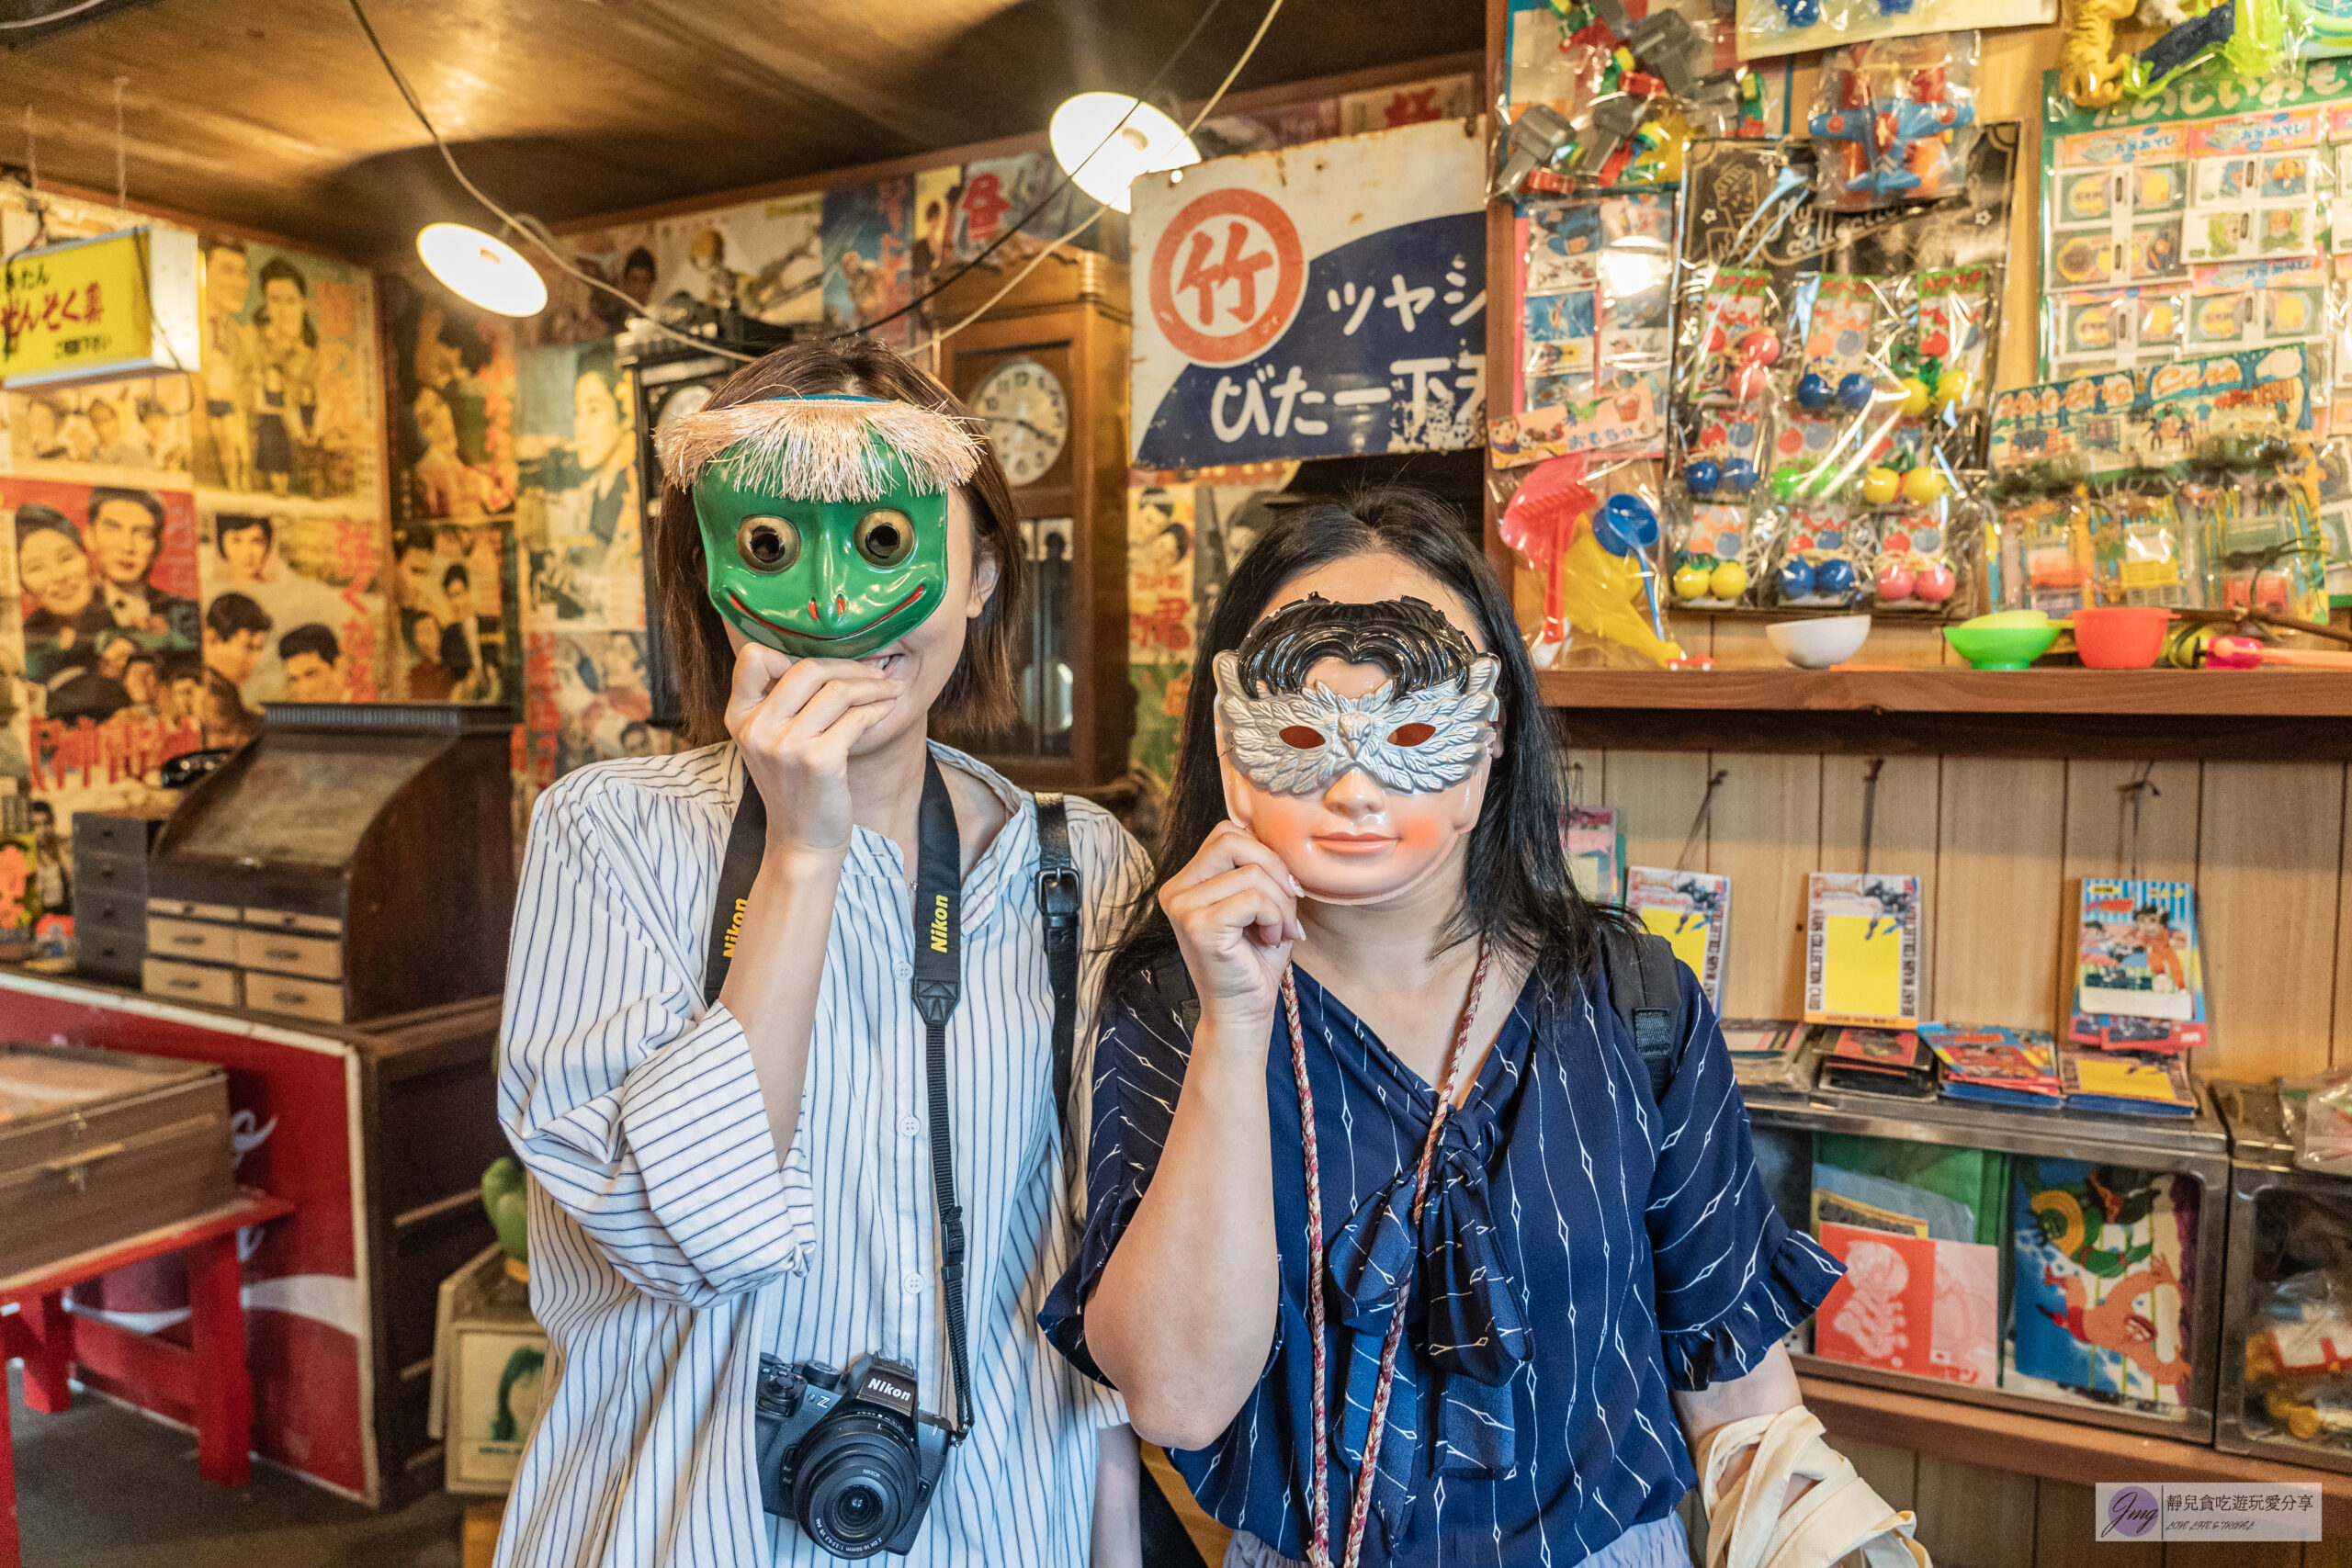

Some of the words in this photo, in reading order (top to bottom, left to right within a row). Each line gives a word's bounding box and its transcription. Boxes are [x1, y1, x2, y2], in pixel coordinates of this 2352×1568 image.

[1176, 221, 1273, 326] 竹
[931, 895, 948, 953] Nikon
[817, 1395, 831, 1409] Z
[868, 1378, 911, 1402] Nikon
[863, 1468, 881, 1479] NIKKOR
